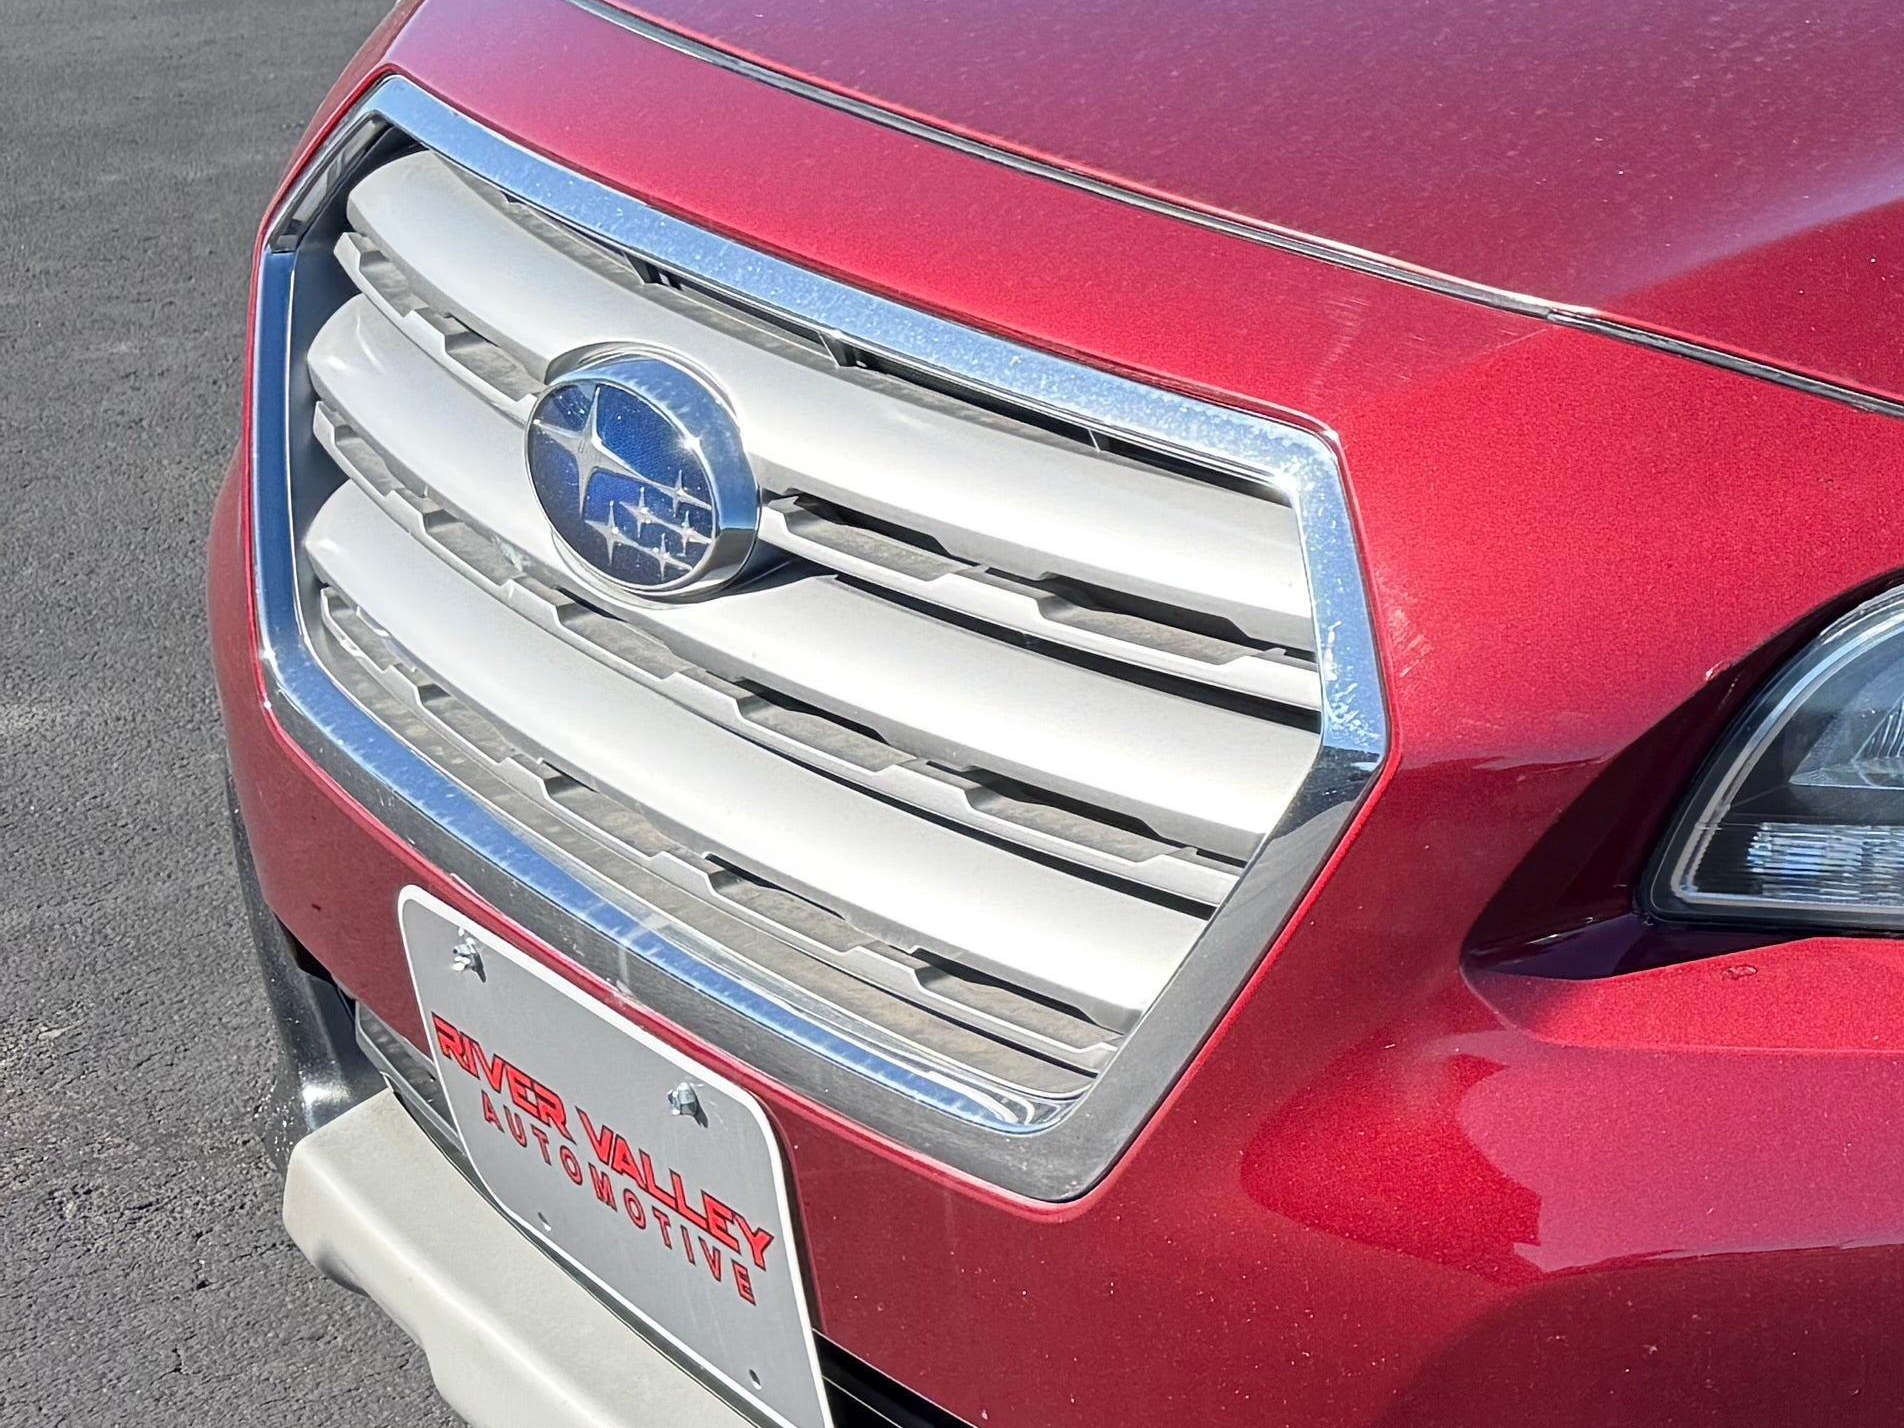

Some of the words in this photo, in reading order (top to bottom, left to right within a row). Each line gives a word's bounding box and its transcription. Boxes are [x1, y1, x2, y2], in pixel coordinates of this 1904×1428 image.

[431, 1011, 578, 1146] RIVER
[575, 1105, 775, 1272] VALLEY
[480, 1089, 758, 1307] AUTOMOTIVE
